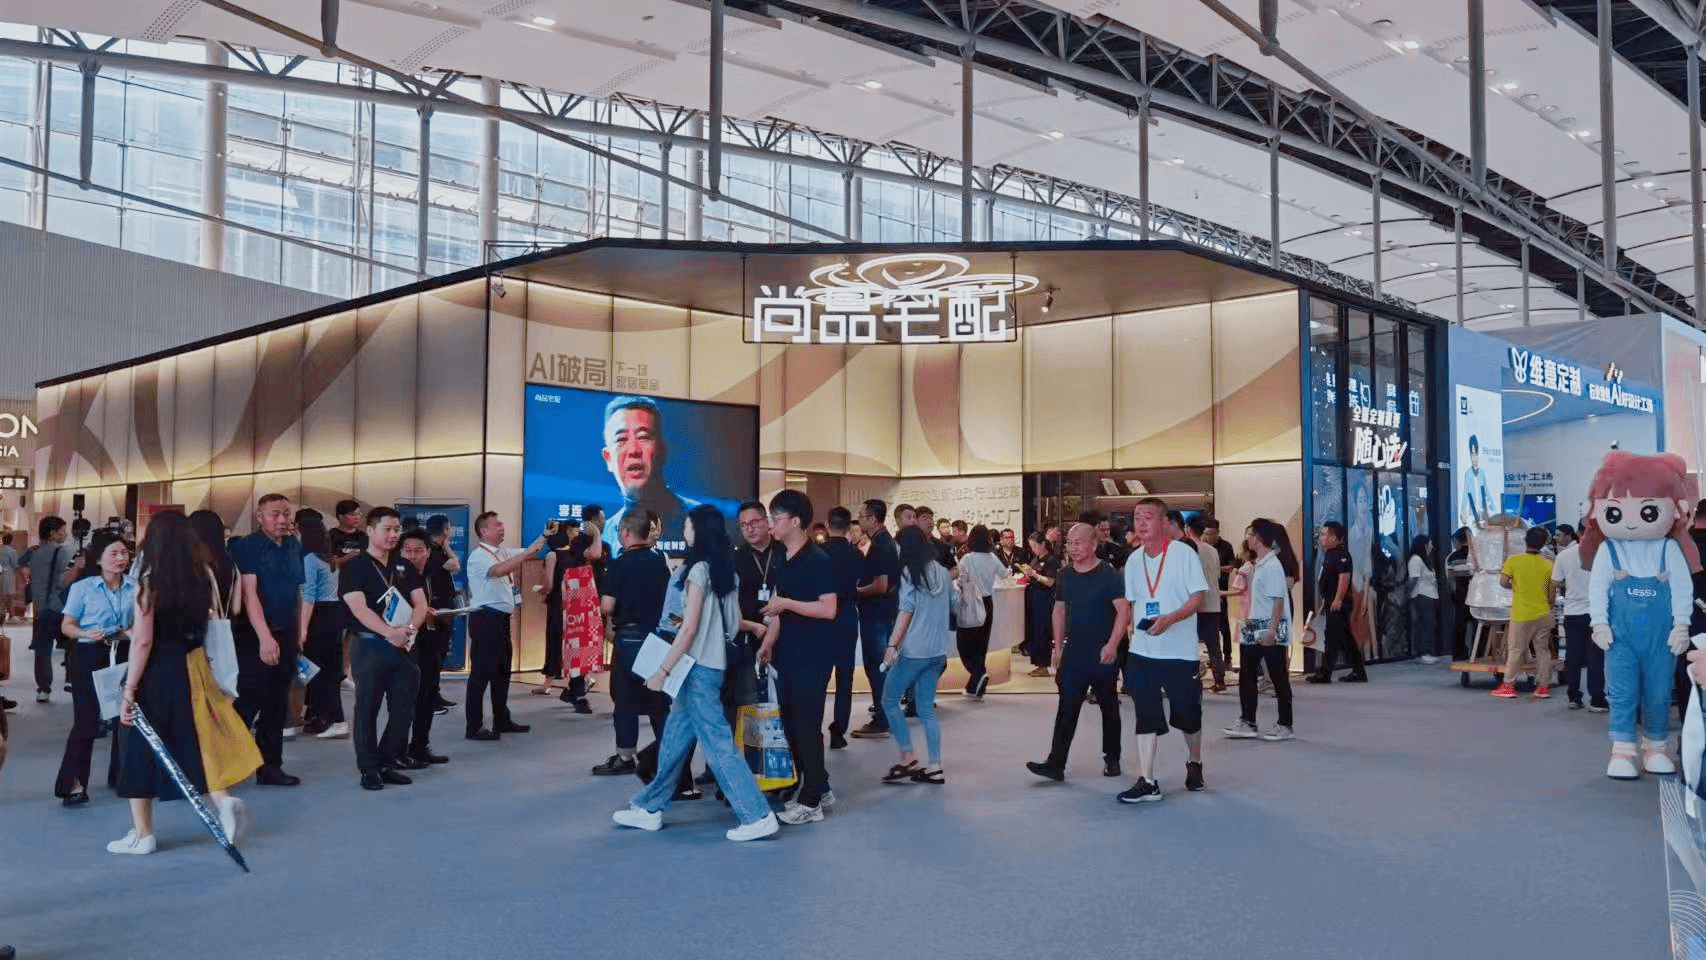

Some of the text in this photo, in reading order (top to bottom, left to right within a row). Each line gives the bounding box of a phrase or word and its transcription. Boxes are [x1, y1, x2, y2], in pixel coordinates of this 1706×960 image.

[753, 285, 1007, 343] 尚品宅配
[529, 352, 607, 387] AI破局
[1529, 354, 1582, 397] 维意定制
